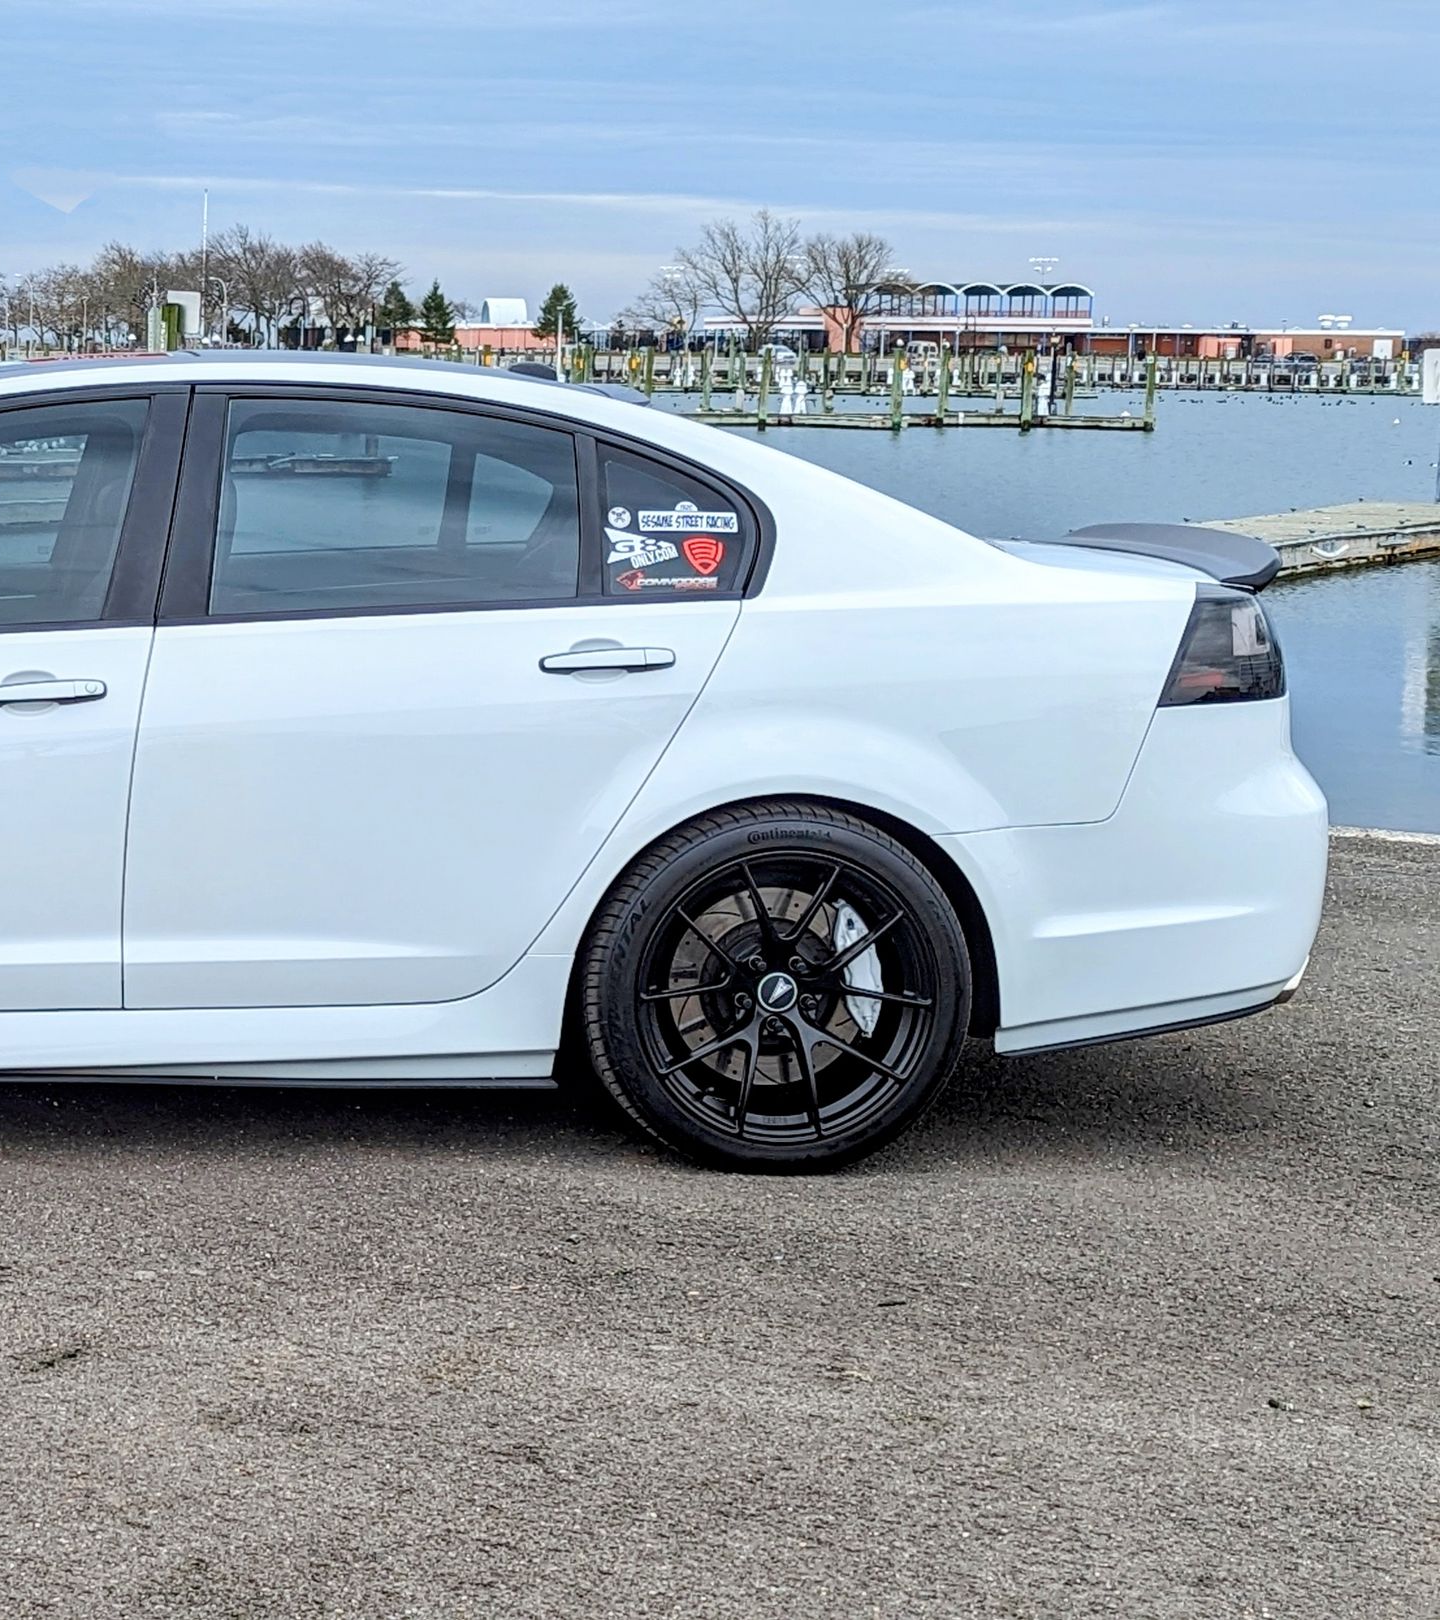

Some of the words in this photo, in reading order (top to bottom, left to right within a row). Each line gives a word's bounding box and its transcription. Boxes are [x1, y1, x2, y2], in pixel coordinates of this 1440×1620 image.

[641, 514, 672, 527] SESAME
[675, 515, 703, 528] STREET
[706, 516, 735, 529] RACING
[630, 546, 679, 569] ONLY.COM
